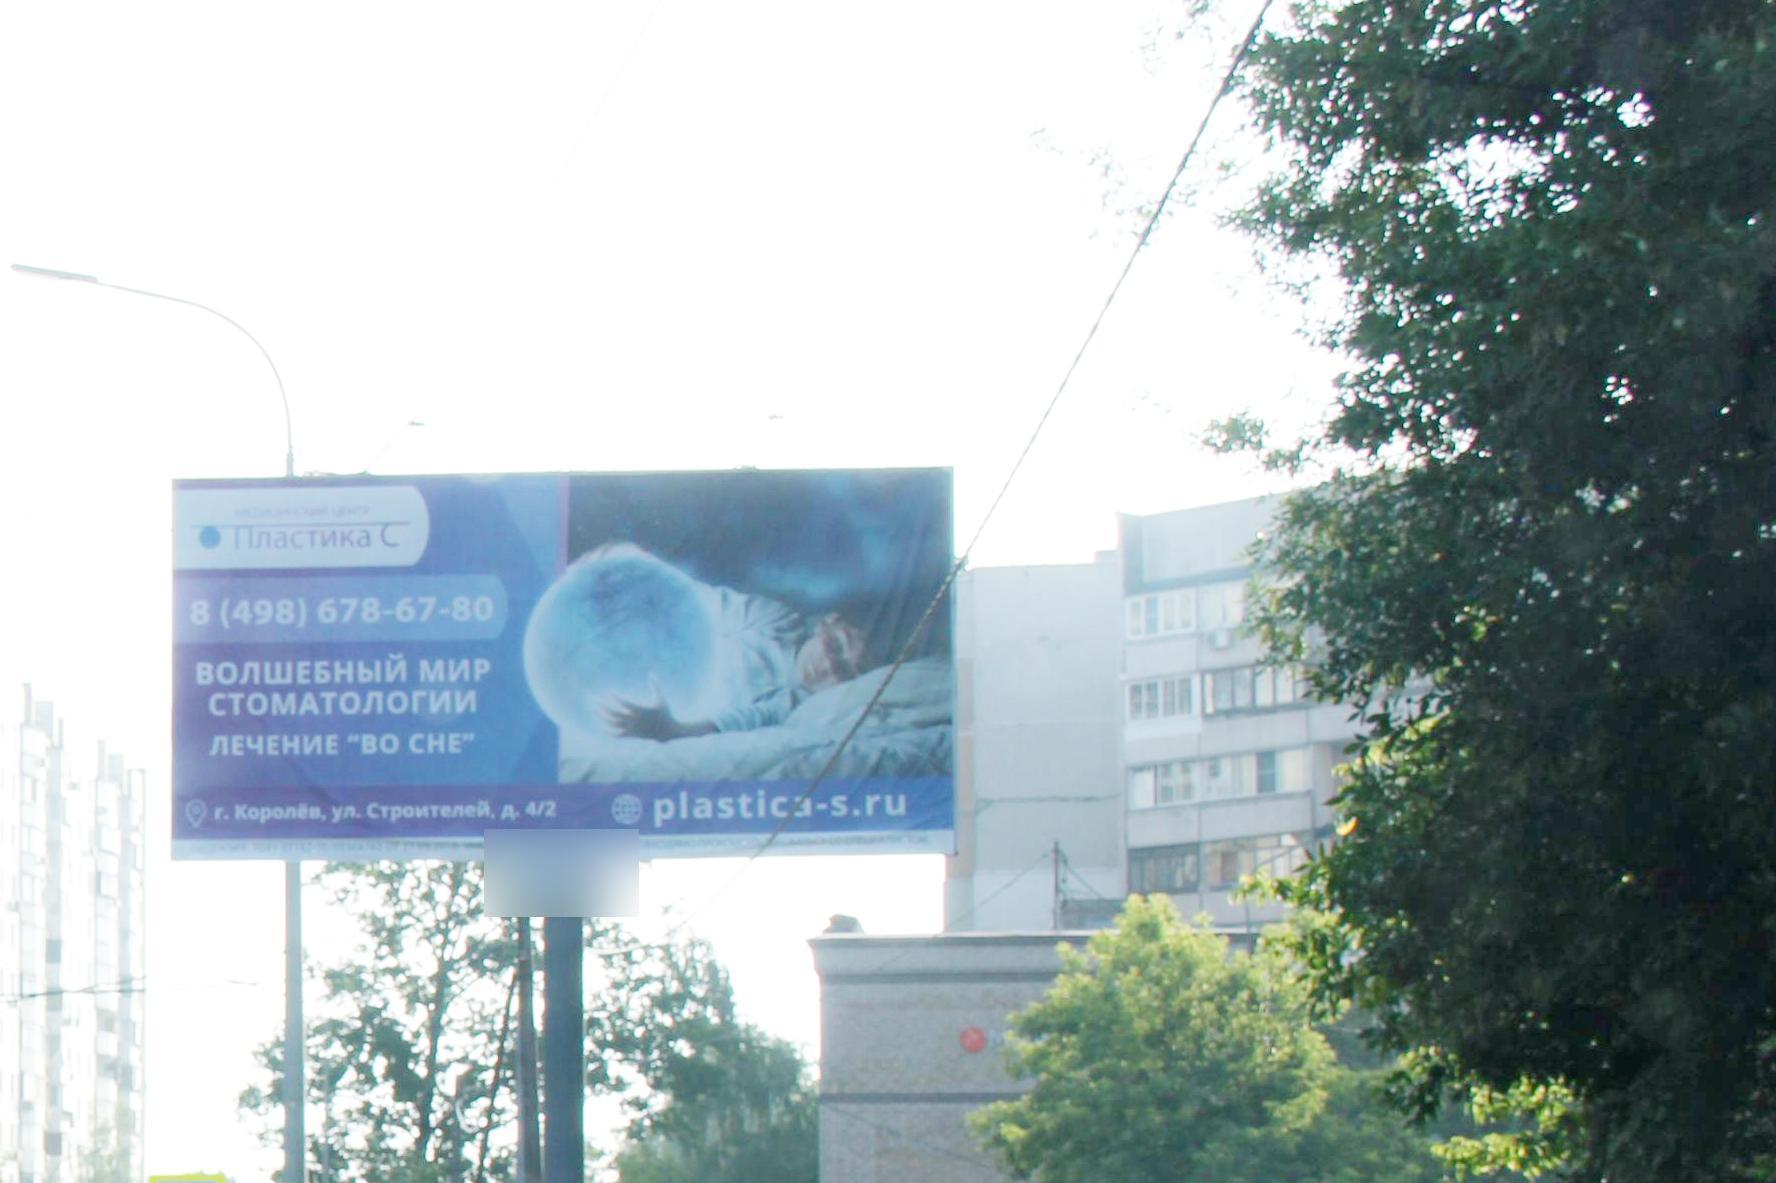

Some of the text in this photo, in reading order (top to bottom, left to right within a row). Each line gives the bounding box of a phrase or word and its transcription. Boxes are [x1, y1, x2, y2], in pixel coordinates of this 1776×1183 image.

[235, 525, 372, 549] Пластика
[190, 597, 494, 628] 8 (498) 678-67-80
[196, 654, 491, 686] ВОЛШЕБНЫЙ МИР
[209, 690, 477, 716] СТОМАТОЛОГИИ
[209, 735, 338, 756] ЛЕЧЕНИЕ
[214, 800, 557, 823] г. Королёв, ул. Строителей, д. 4/2
[653, 789, 907, 827] plastica-s.ru
